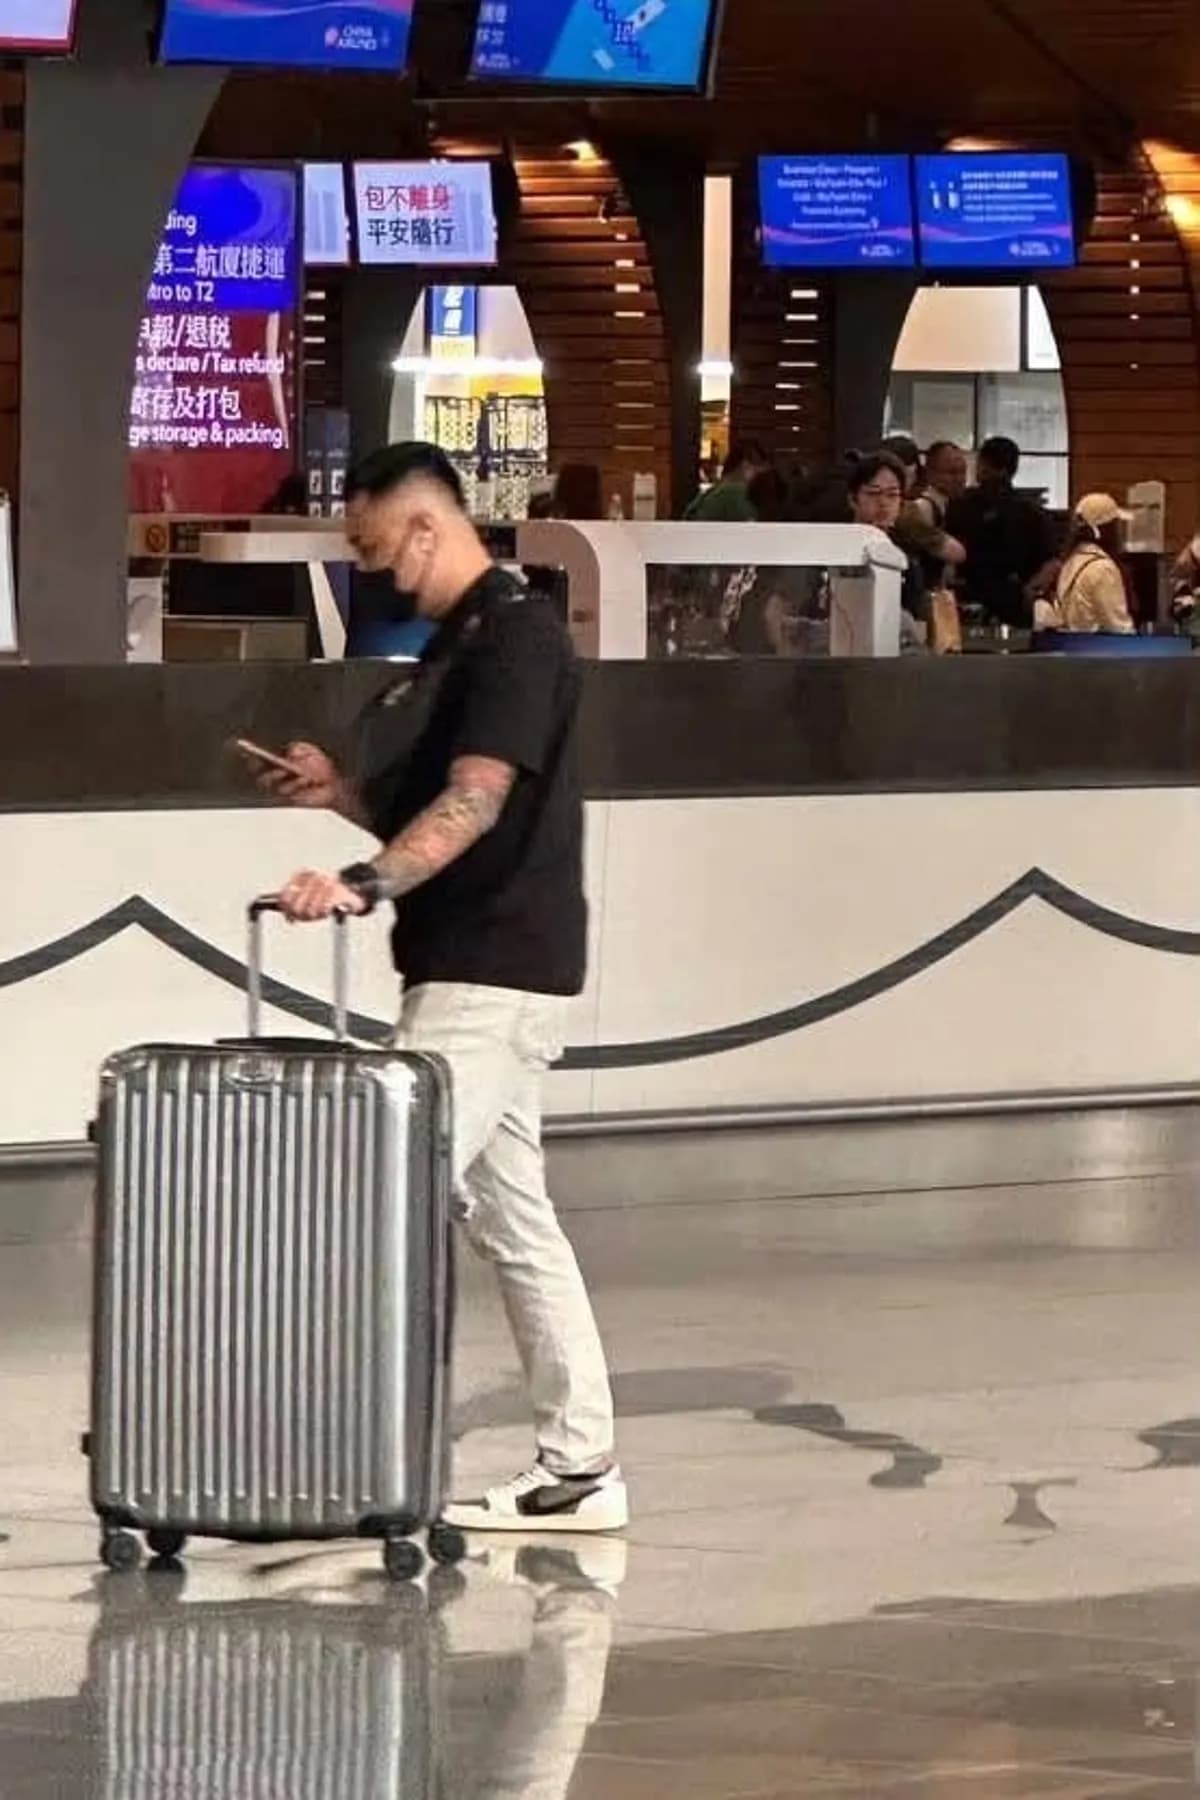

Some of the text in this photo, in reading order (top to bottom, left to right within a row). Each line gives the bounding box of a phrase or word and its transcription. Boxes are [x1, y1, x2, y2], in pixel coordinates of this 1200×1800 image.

[175, 284, 192, 301] to
[195, 281, 214, 302] T2
[147, 351, 200, 372] declare
[211, 352, 237, 371] Tax
[239, 351, 285, 373] refund
[151, 424, 208, 446] storage
[210, 421, 224, 442] &
[225, 422, 282, 448] packing
